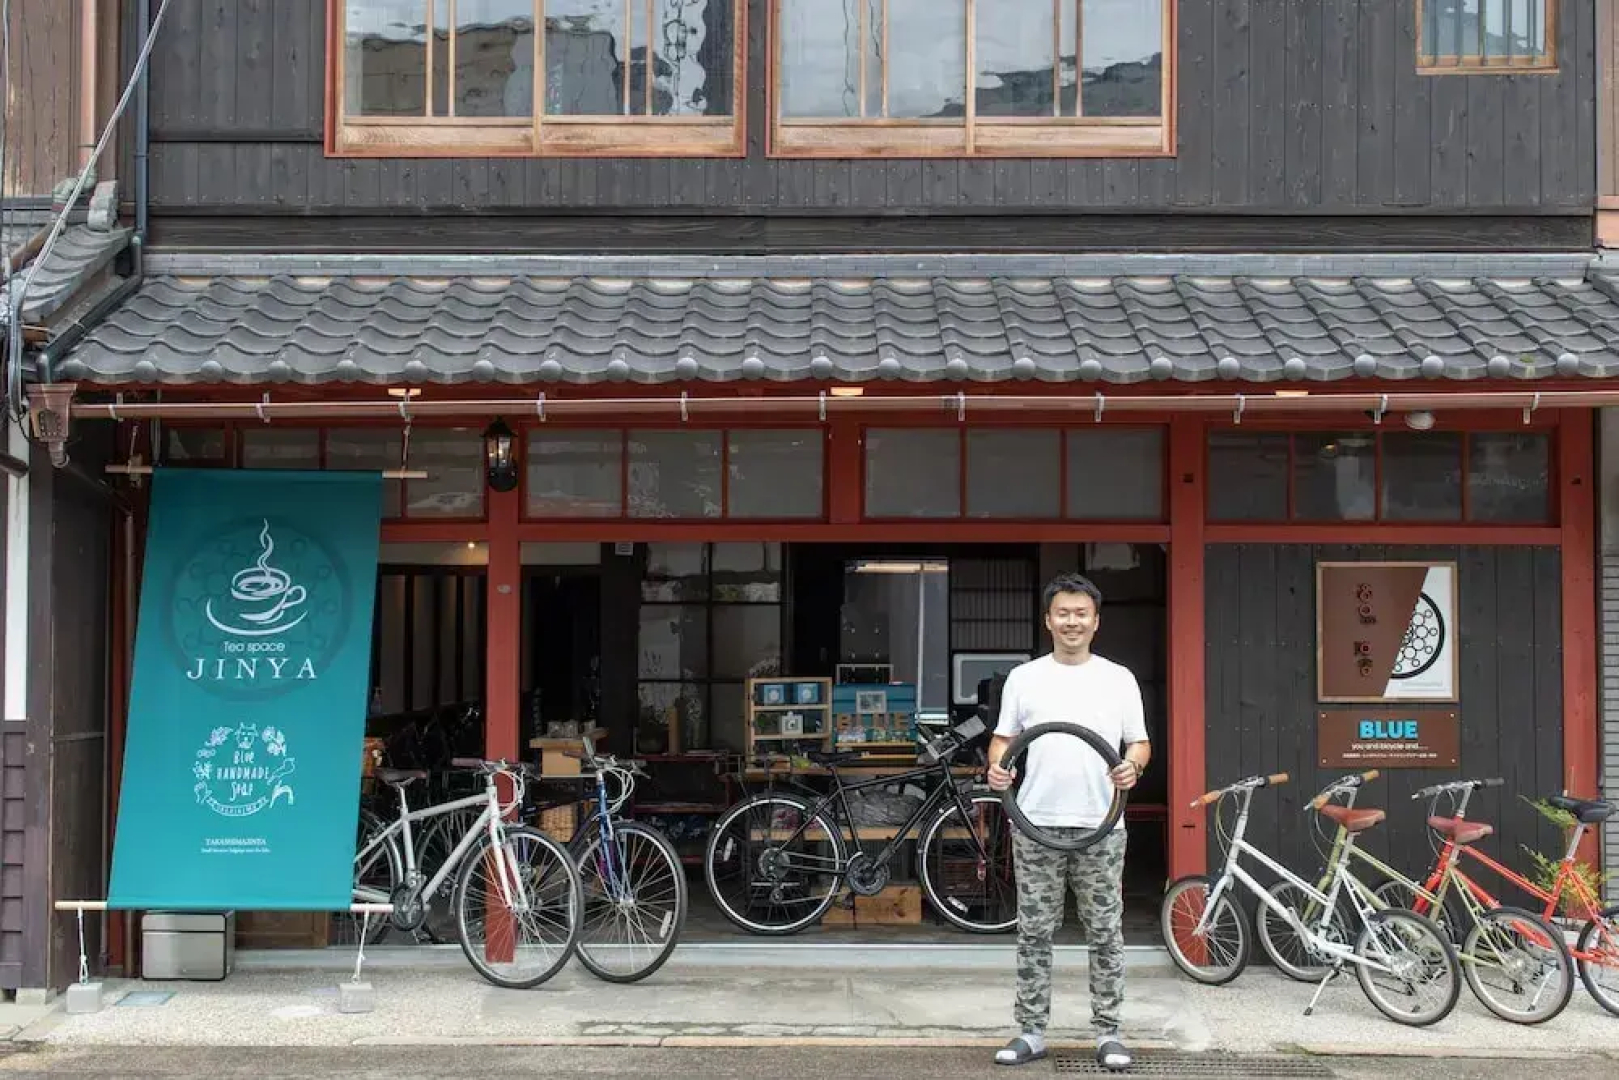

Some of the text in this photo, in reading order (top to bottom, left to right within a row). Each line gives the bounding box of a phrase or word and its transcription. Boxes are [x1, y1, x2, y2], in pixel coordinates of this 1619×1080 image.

[223, 640, 286, 654] Tea space
[186, 658, 317, 680] JINYA
[1359, 720, 1418, 740] BLUE
[1351, 743, 1363, 751] you
[1365, 742, 1378, 750] and
[1380, 742, 1404, 751] bicycle
[216, 766, 270, 780] HANDMADE
